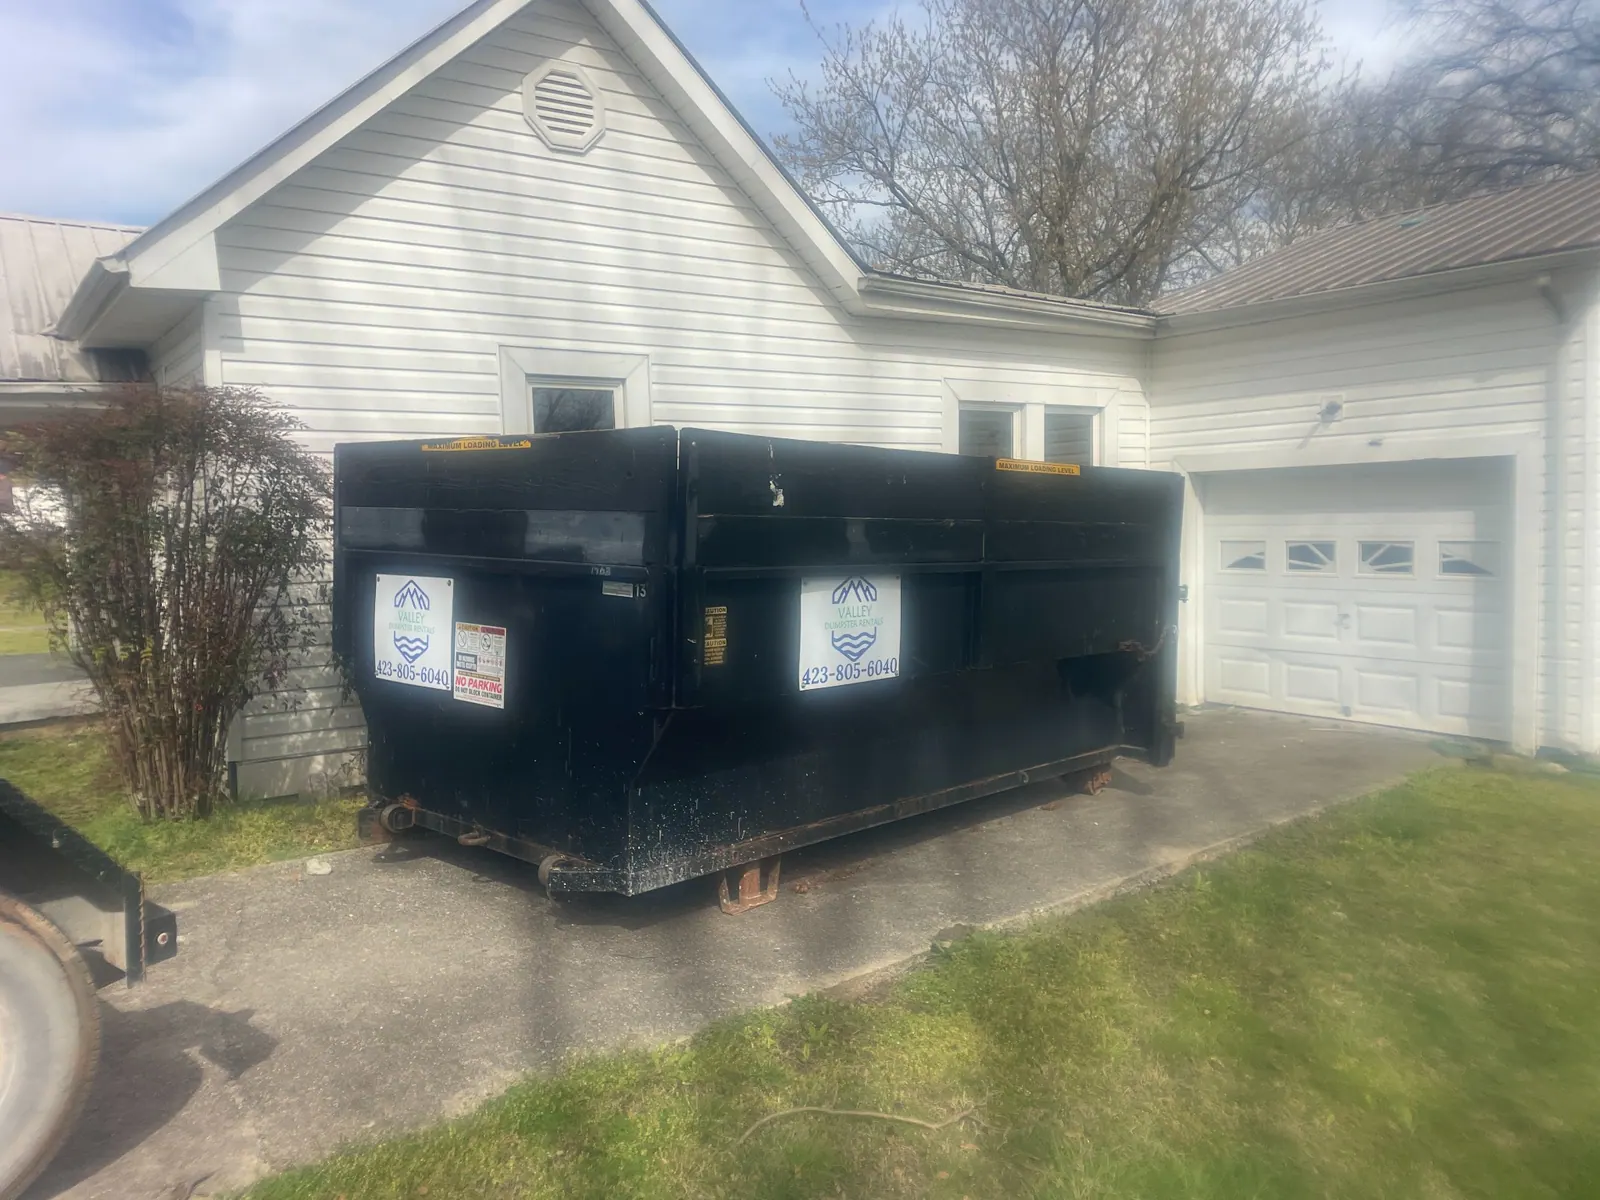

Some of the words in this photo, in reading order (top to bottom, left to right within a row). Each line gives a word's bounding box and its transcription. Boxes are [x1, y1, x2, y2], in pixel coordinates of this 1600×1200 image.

[427, 442, 461, 450] MAXIMUM
[463, 441, 496, 449] LOADING
[998, 462, 1029, 471] MAXIMUM
[1030, 465, 1056, 473] LOADING
[398, 611, 426, 624] VALLEY
[838, 604, 873, 619] VALLEY
[824, 619, 858, 630] DUMPSTER
[859, 617, 884, 628] RENTALS
[376, 660, 449, 687] 423-805-6040
[802, 657, 898, 685] 423-805-6040
[455, 676, 467, 687] NO
[468, 678, 503, 694] PARKING
[469, 688, 481, 697] BLOCK
